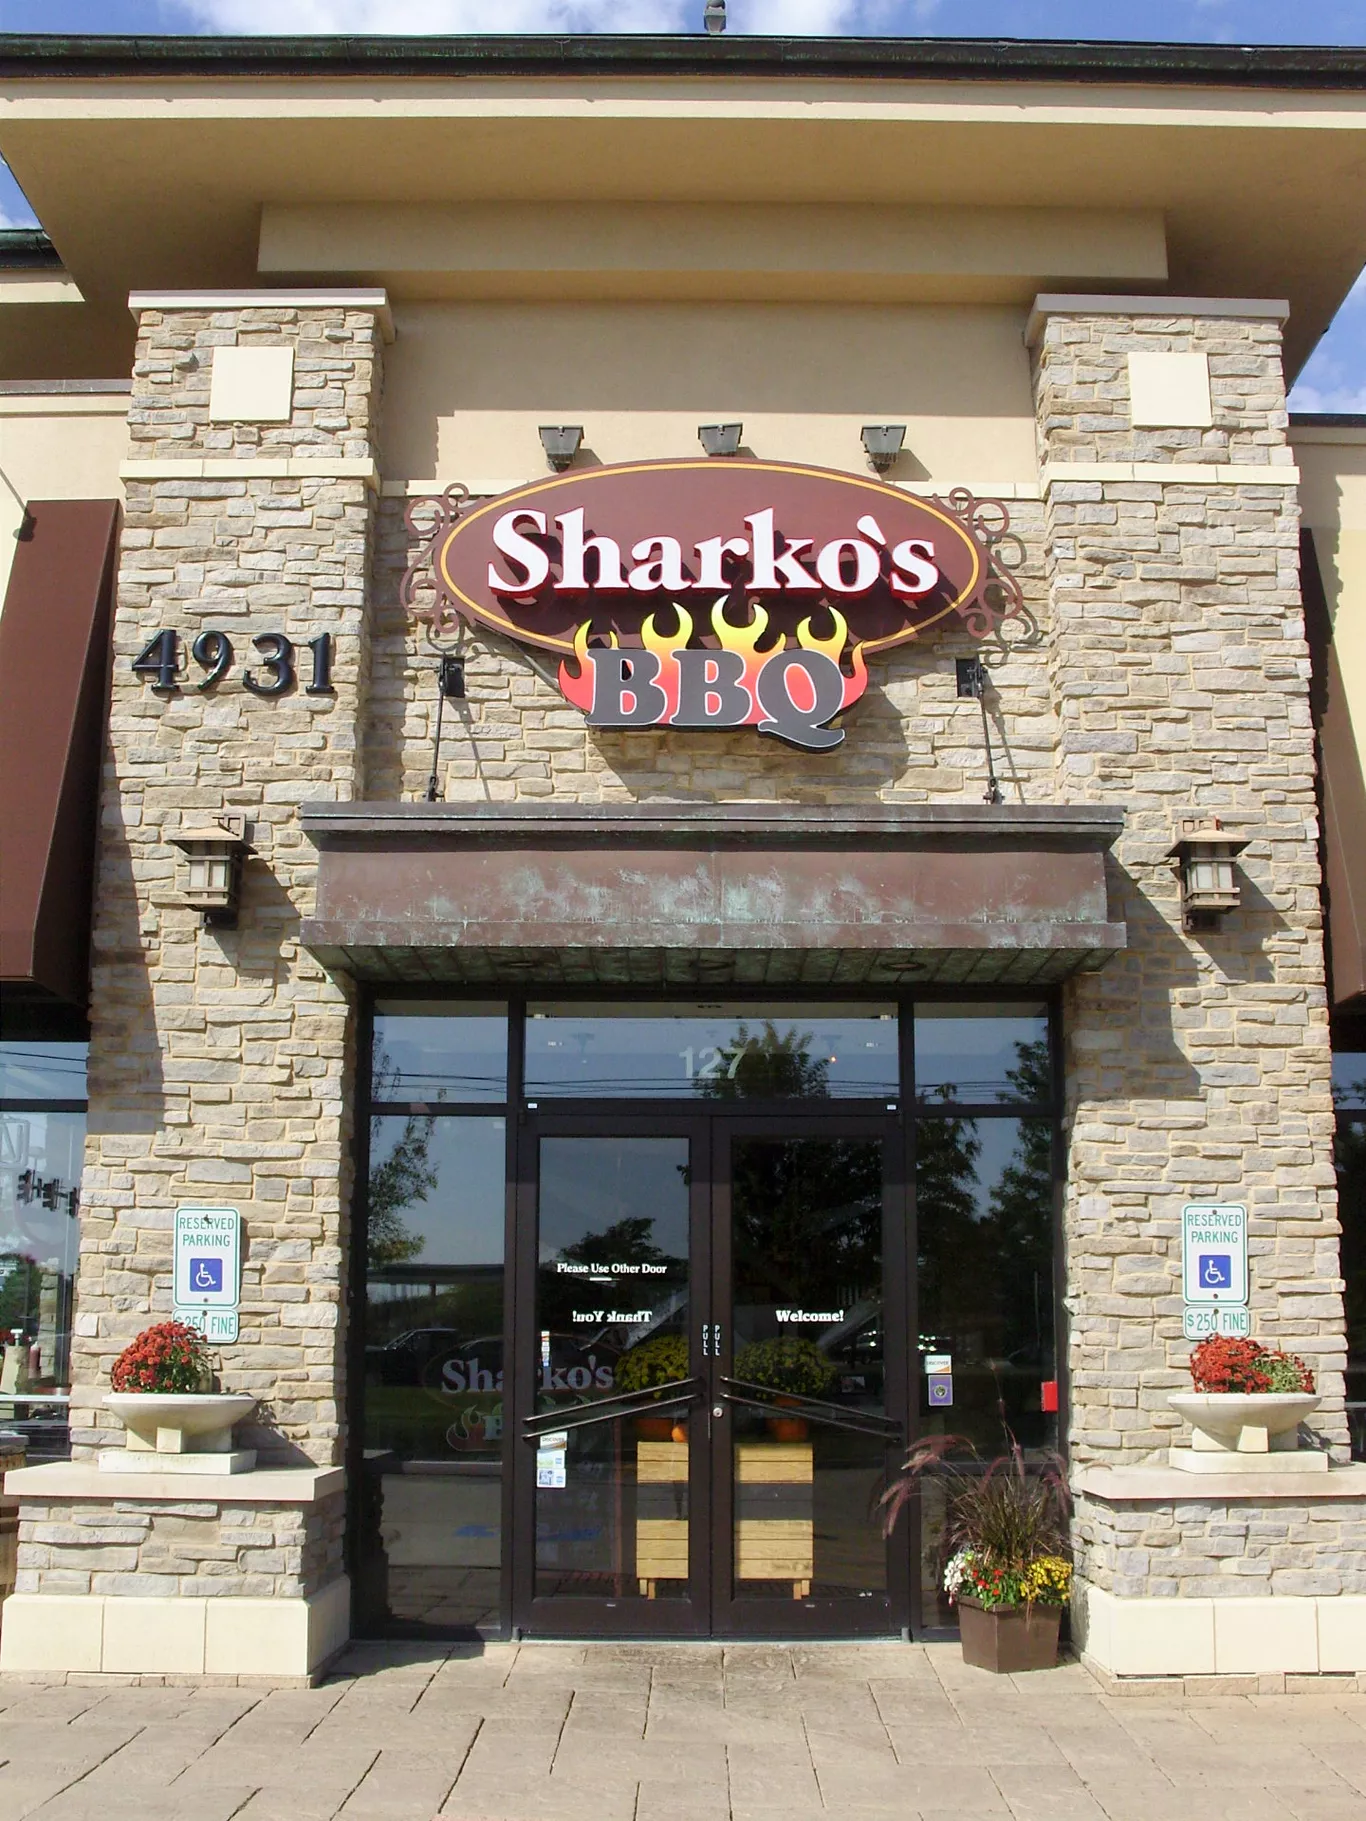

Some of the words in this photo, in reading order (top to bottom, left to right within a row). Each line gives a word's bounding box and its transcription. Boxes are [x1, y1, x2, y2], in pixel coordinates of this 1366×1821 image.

[486, 506, 941, 595] Sharko's
[131, 629, 335, 697] 4931
[584, 647, 847, 753] BBQ
[678, 1045, 748, 1080] 127
[179, 1216, 235, 1231] RESERVED
[1187, 1213, 1242, 1227] RESERVED
[182, 1233, 231, 1248] PARKING
[1191, 1230, 1239, 1244] PARKING
[557, 1262, 589, 1274] Please
[590, 1262, 610, 1274] Use
[611, 1263, 640, 1274] Other
[641, 1263, 668, 1274] Door
[211, 1316, 235, 1335] FINE
[775, 1309, 844, 1323] Welcome!
[1223, 1312, 1247, 1331] FINE
[441, 1354, 614, 1395] Shko's
